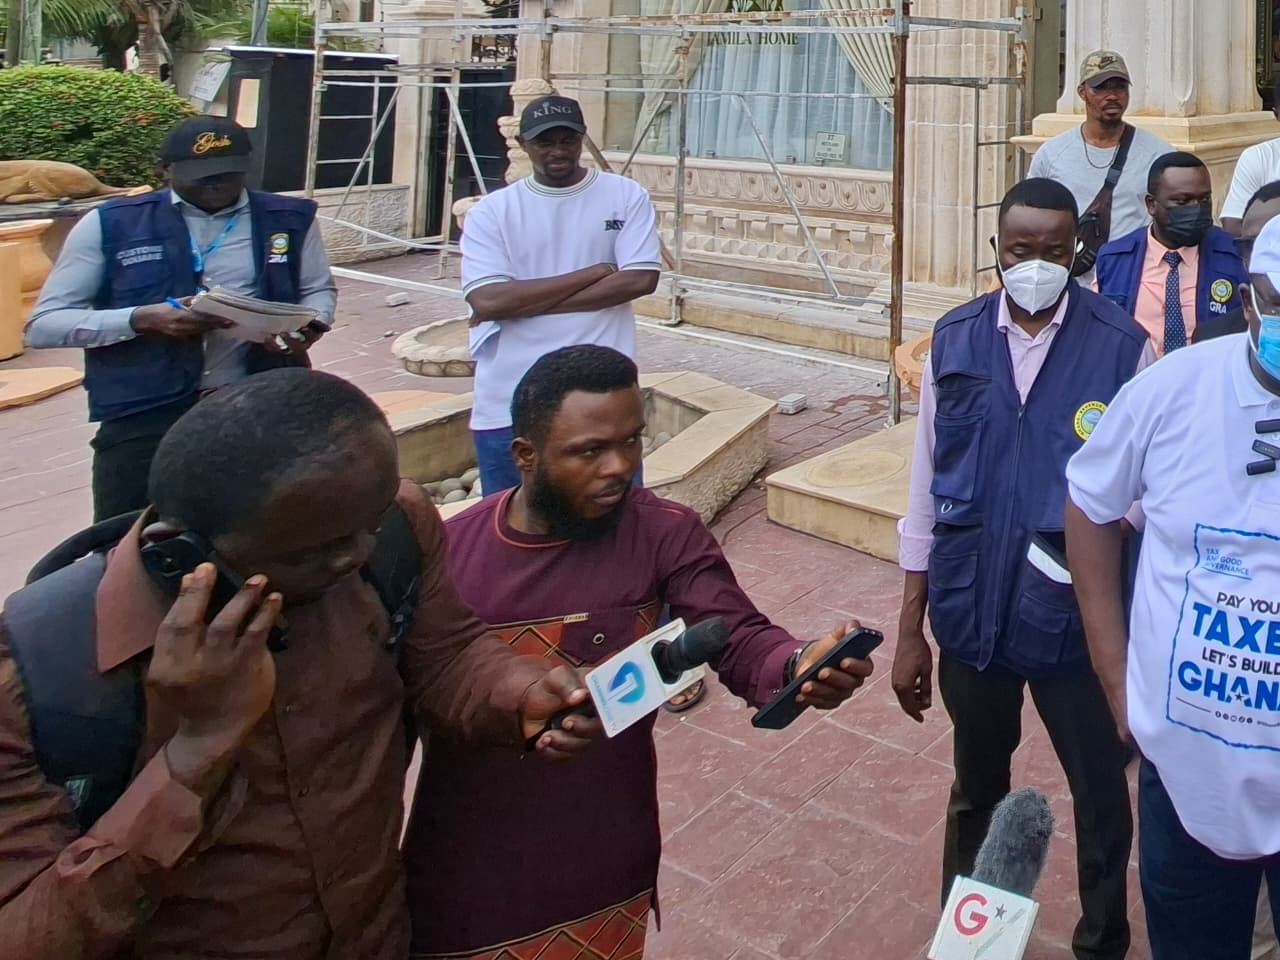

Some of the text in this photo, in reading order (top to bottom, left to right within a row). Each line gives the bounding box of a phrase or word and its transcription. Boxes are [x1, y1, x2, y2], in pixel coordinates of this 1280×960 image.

[758, 31, 800, 46] HOME
[533, 101, 573, 118] KING
[1210, 301, 1227, 314] GRA
[1220, 555, 1243, 566] GOOD
[1216, 591, 1246, 608] PAY
[1202, 646, 1238, 669] LET'S
